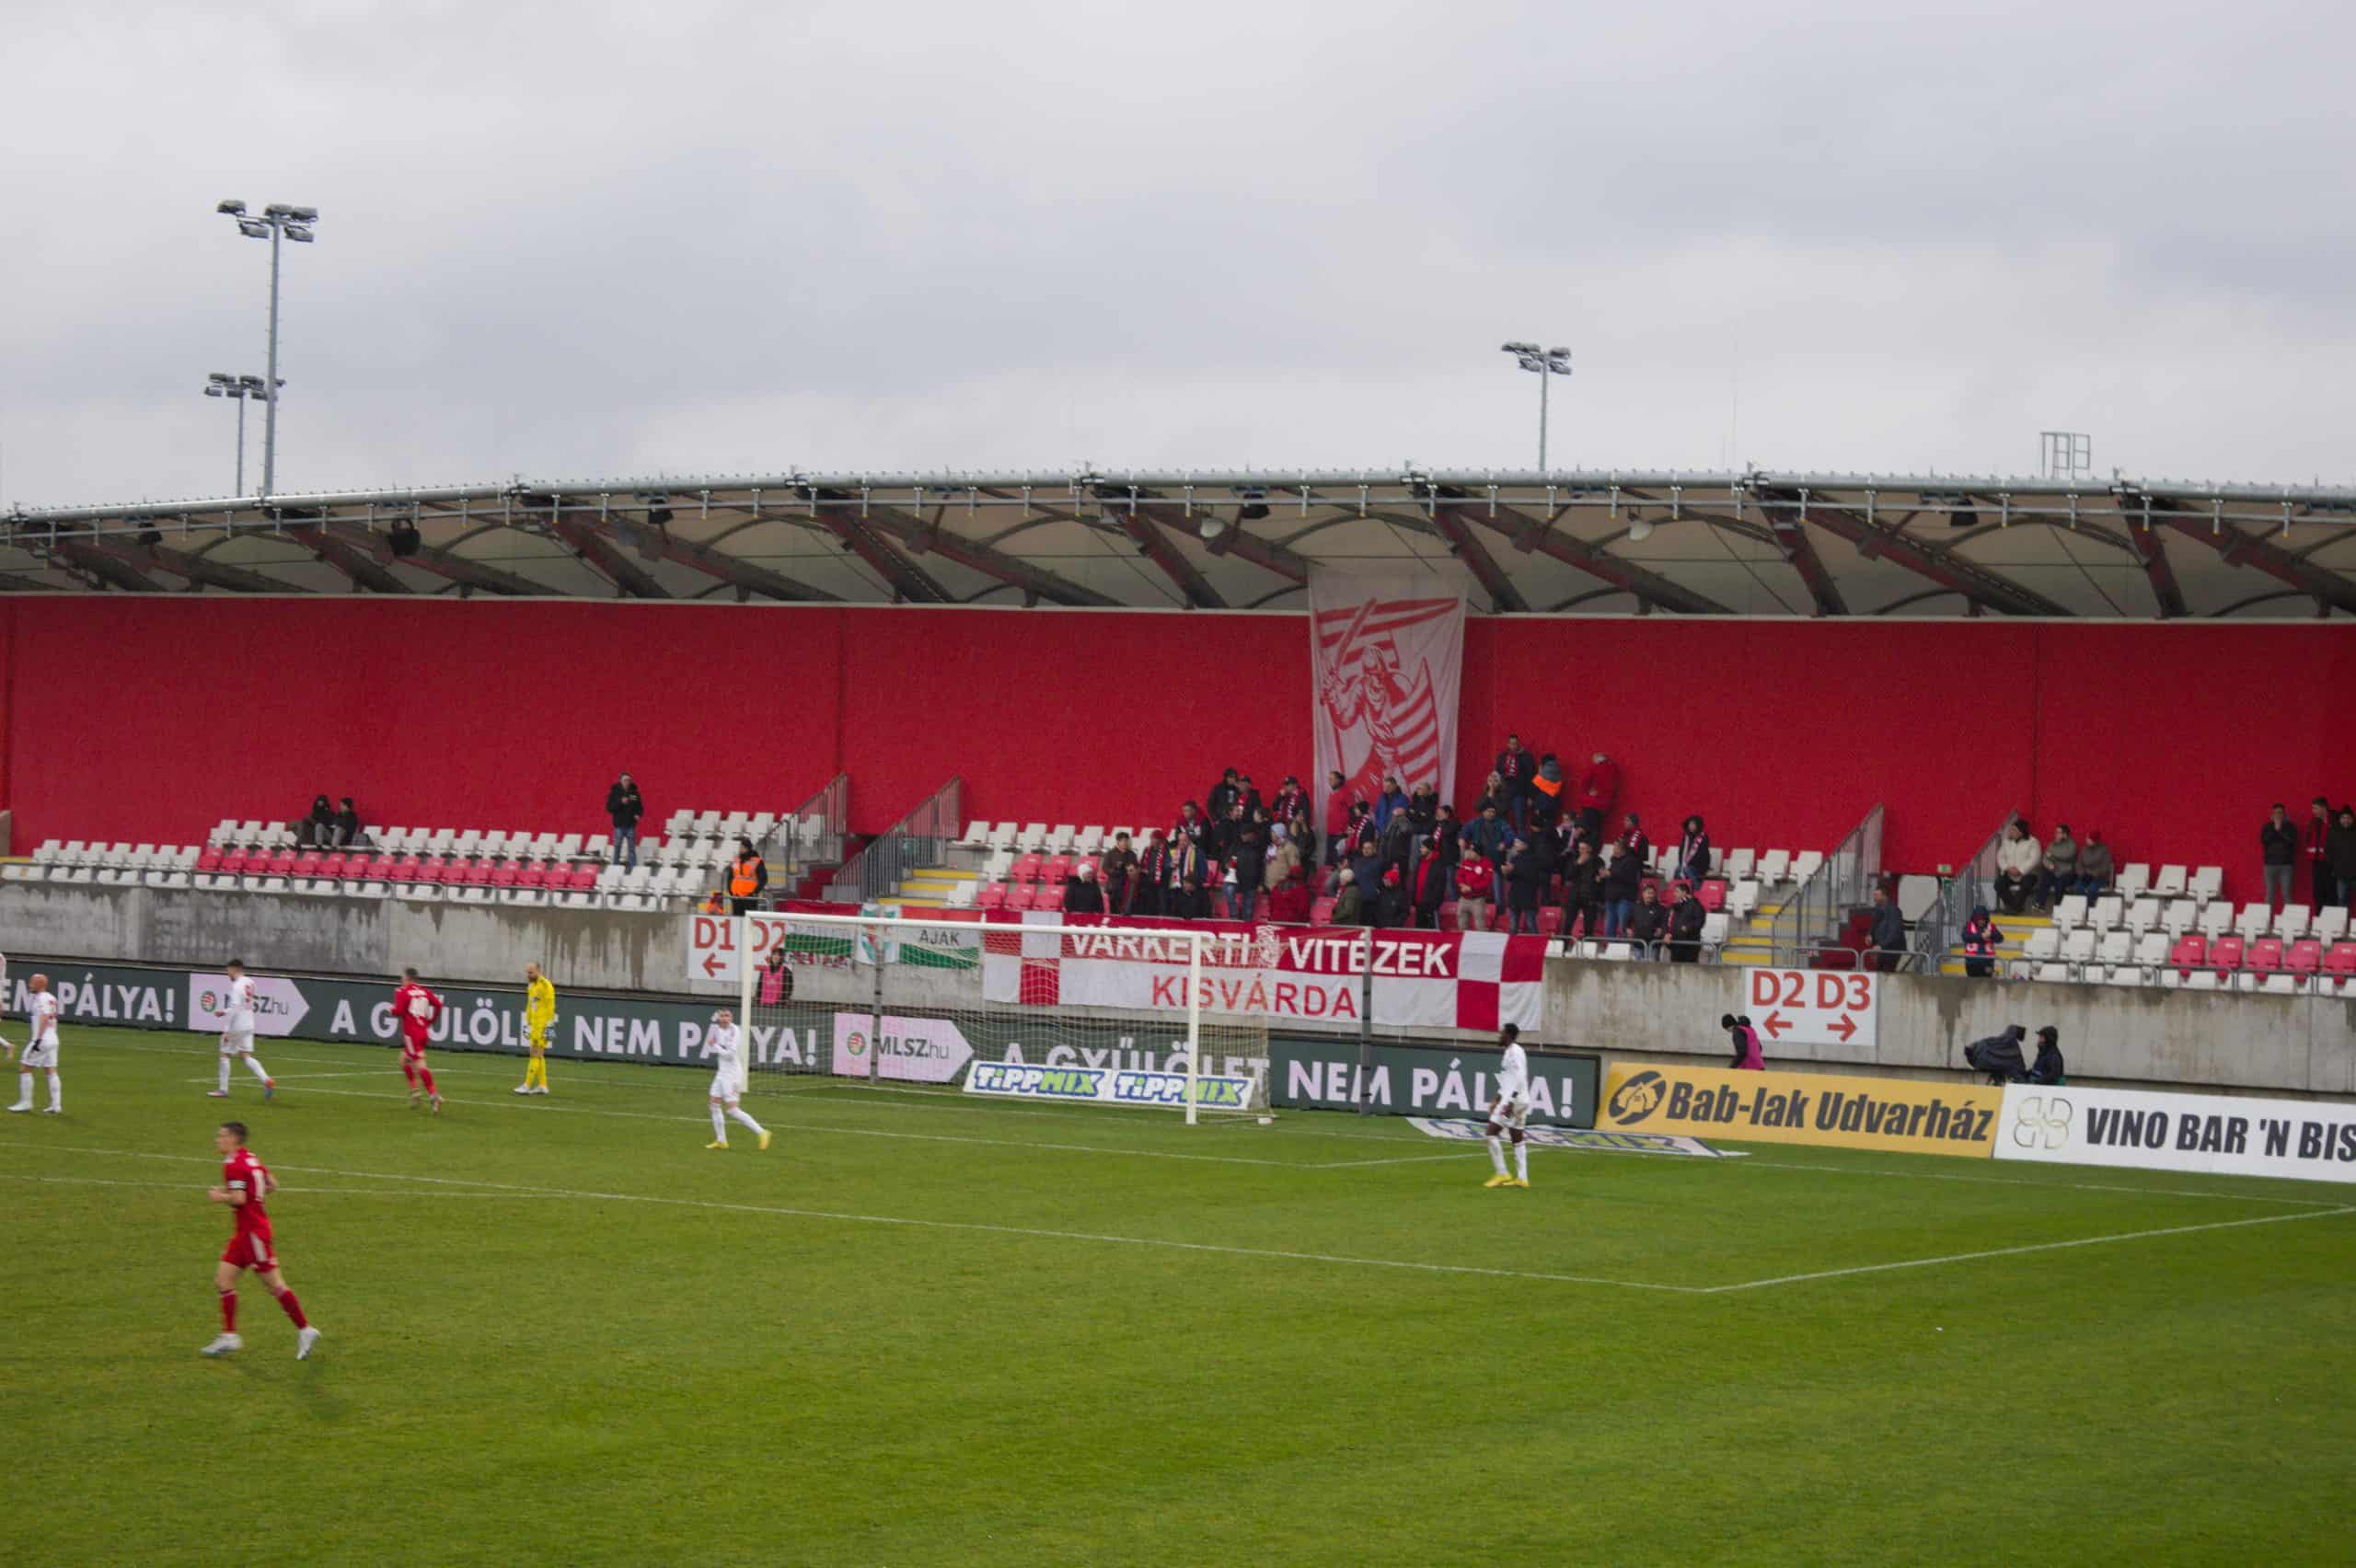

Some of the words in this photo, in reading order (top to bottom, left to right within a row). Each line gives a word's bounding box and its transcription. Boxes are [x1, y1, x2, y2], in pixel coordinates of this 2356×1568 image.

[694, 917, 735, 951] D1
[919, 928, 960, 946] AJAK
[1069, 917, 1250, 966] VÁRKERTI
[1288, 932, 1452, 976] VITÉZEK
[57, 972, 175, 1023] PÁLYA!
[1151, 972, 1357, 1019] KISVÁRDA
[1752, 970, 1806, 1009] D2
[1817, 973, 1871, 1011] D3
[329, 999, 356, 1035] A
[573, 1015, 663, 1057] NEM
[678, 1011, 817, 1067] PÁYA!
[1288, 1059, 1392, 1105] NEM
[1666, 1080, 1810, 1129] Bab-lak
[1815, 1091, 1994, 1142] Udvarház
[2086, 1107, 2169, 1150] VINO
[2176, 1113, 2248, 1155] BAR
[2297, 1121, 2356, 1163] BIS
